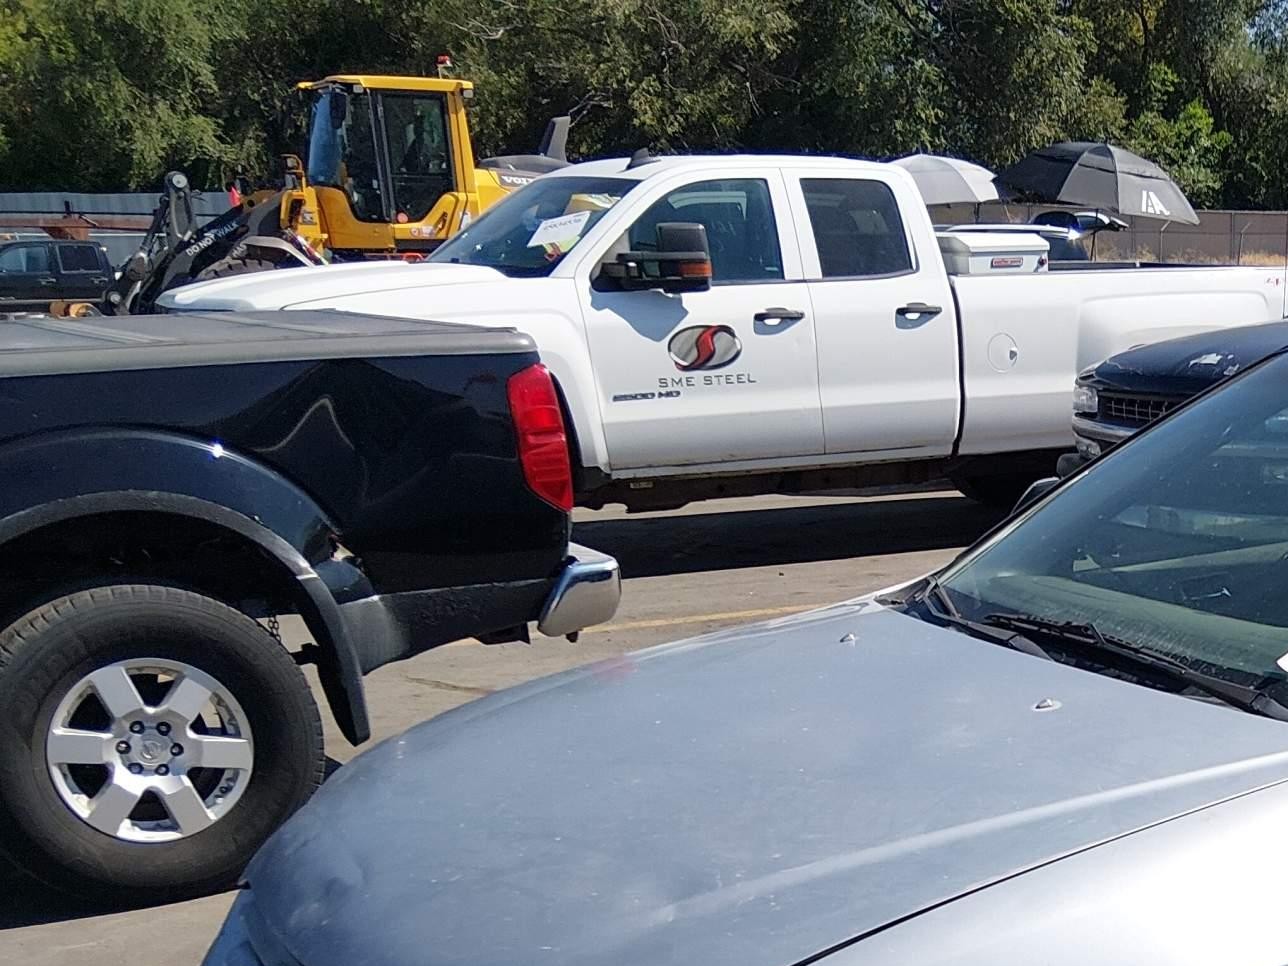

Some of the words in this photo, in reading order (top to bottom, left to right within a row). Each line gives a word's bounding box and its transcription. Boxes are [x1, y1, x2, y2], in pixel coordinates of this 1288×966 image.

[185, 244, 200, 257] DO
[200, 230, 217, 249] NOT
[217, 220, 240, 238] WALK
[658, 376, 695, 388] SME
[703, 373, 757, 386] STEEL
